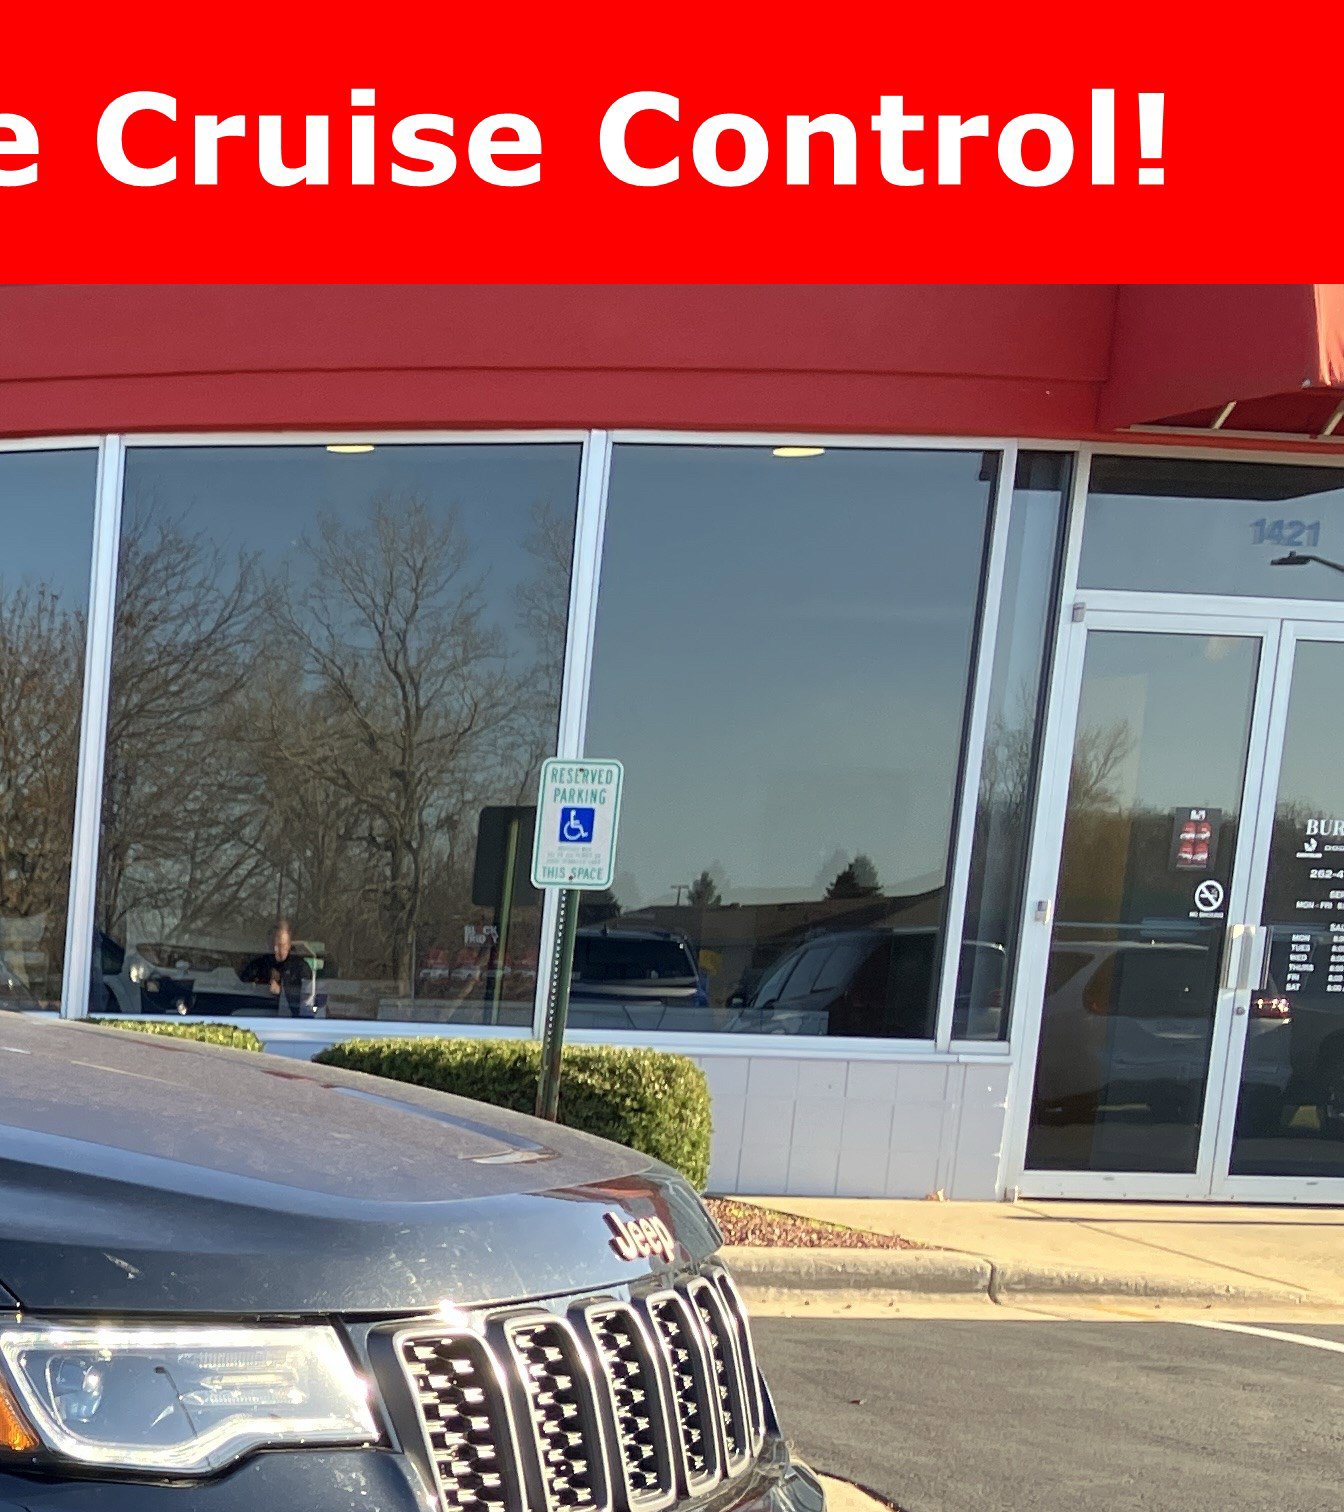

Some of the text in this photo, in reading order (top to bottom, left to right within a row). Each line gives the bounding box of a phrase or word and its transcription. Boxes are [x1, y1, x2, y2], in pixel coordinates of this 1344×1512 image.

[1249, 518, 1320, 547] 1421
[551, 767, 613, 785] RESERVED
[553, 787, 607, 805] PARKING
[542, 865, 605, 881] THIS SPACE
[602, 1211, 675, 1264] Jeep
